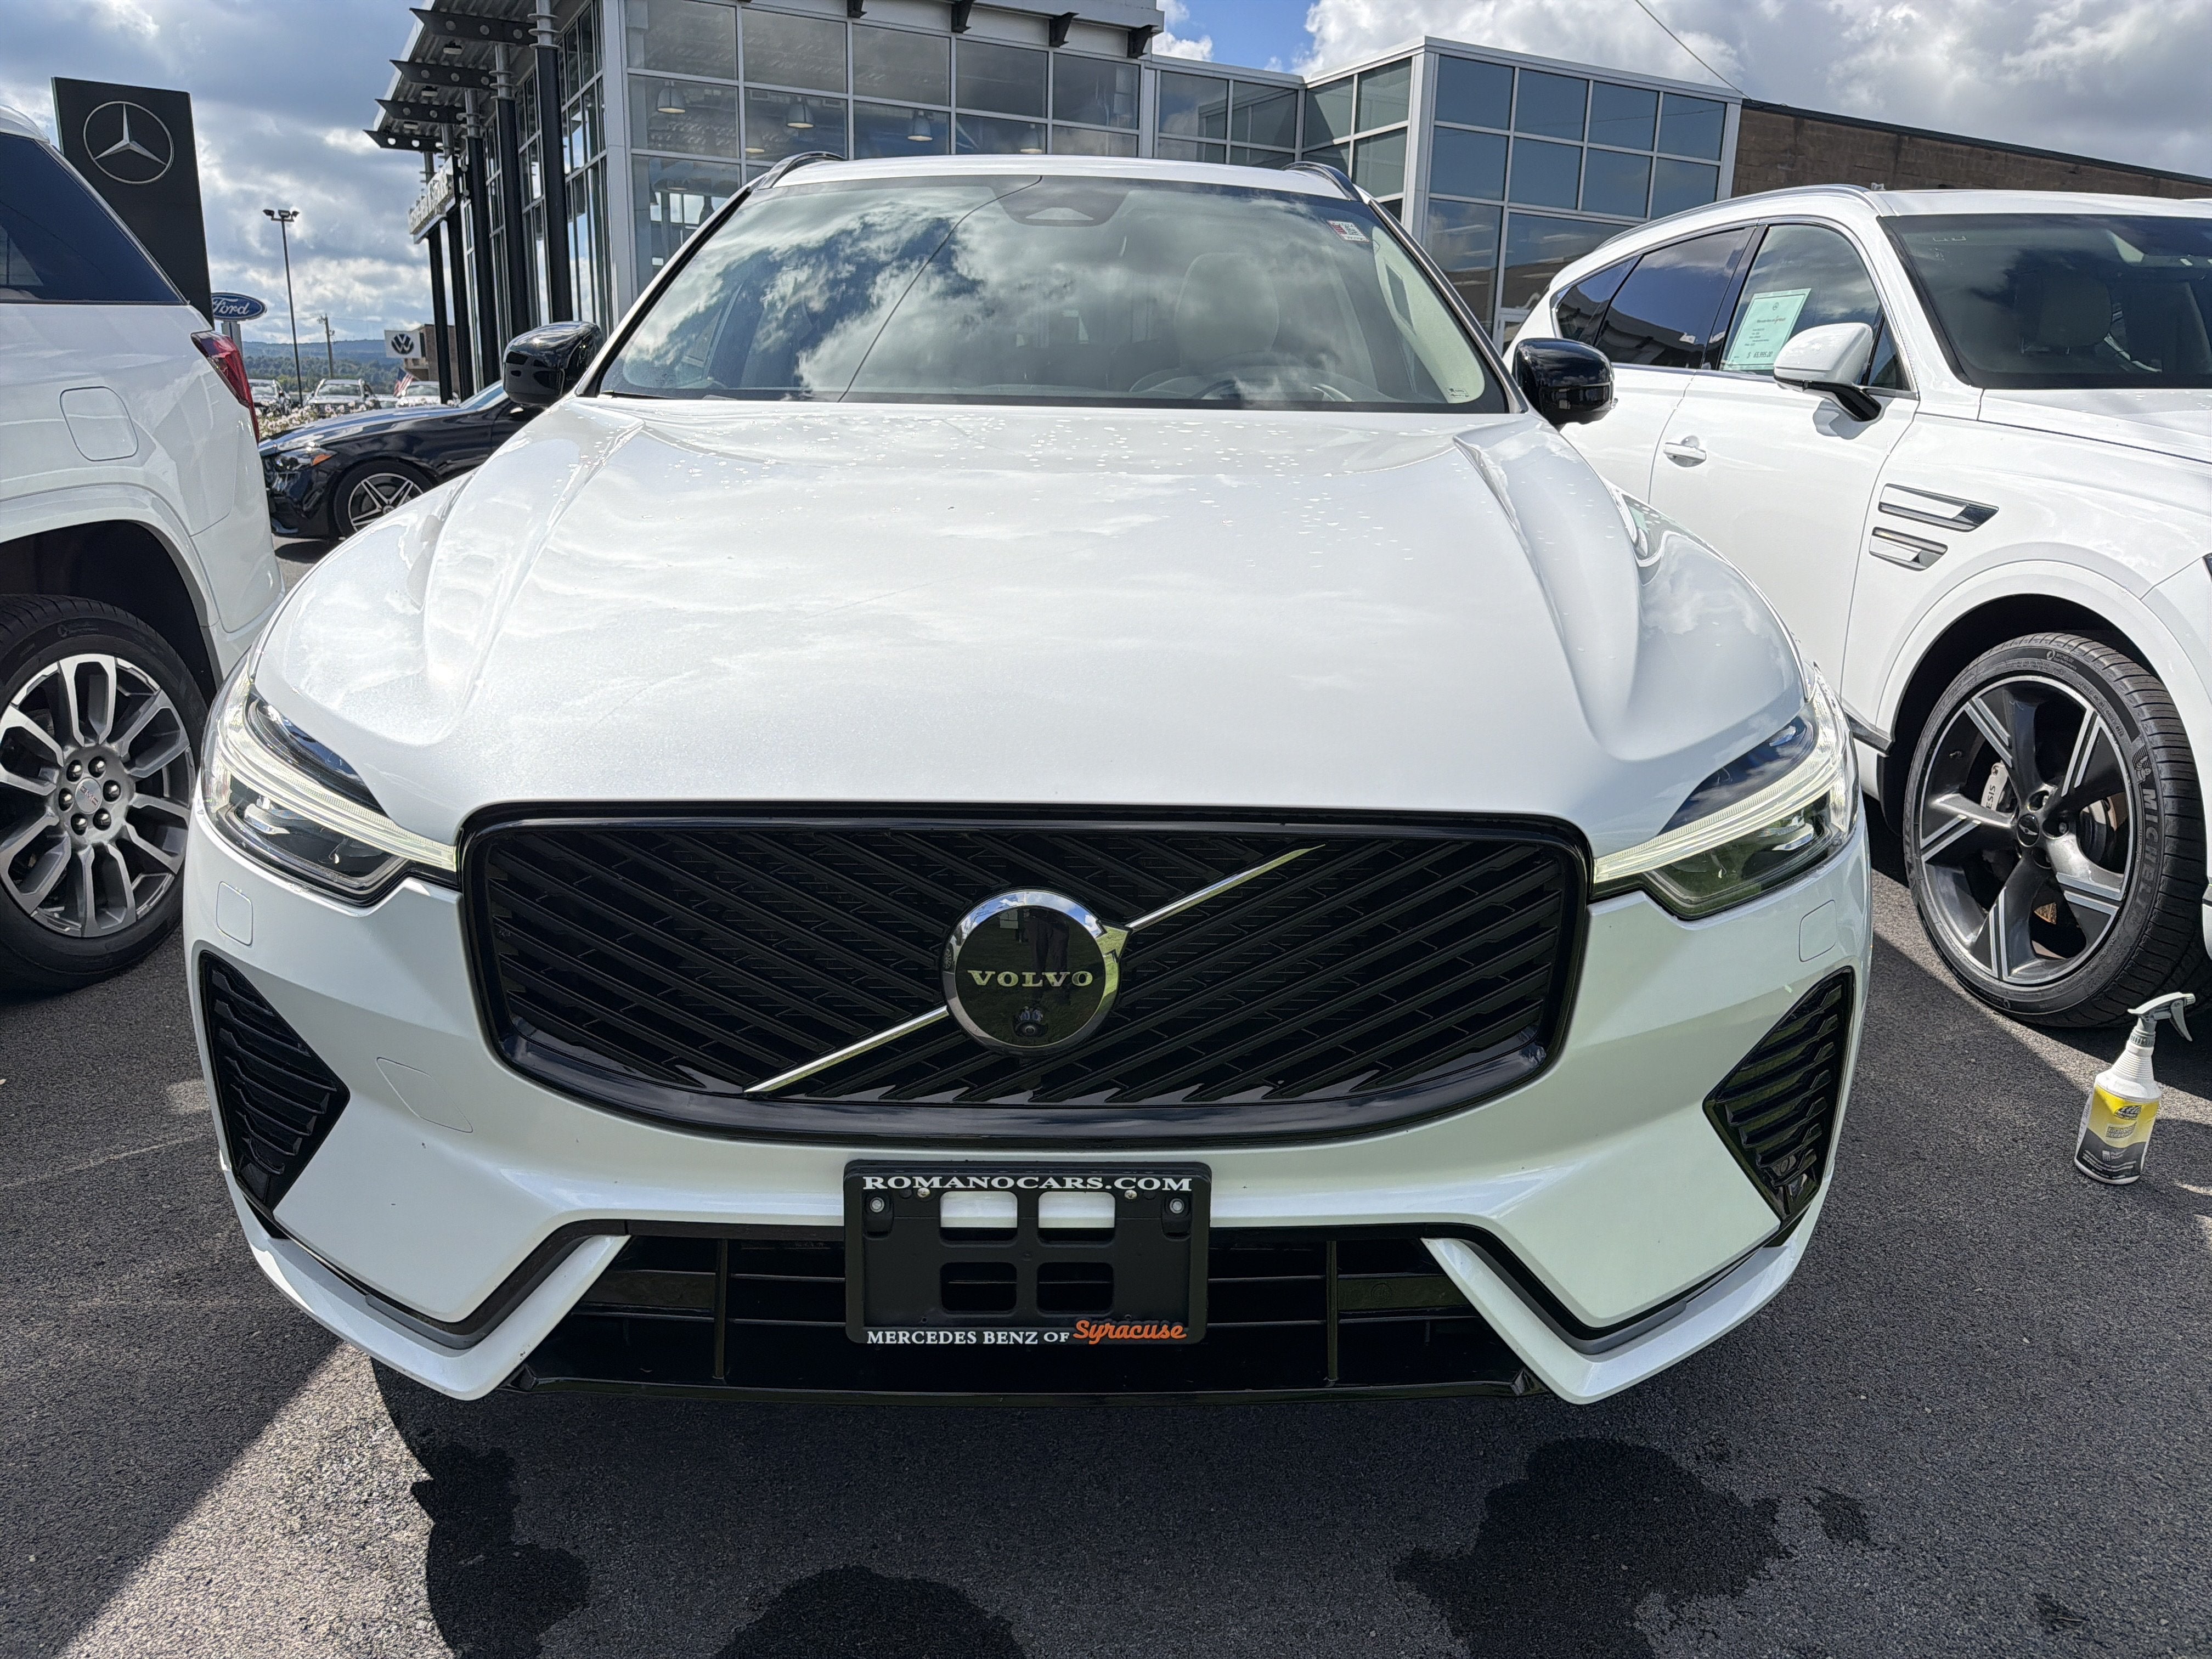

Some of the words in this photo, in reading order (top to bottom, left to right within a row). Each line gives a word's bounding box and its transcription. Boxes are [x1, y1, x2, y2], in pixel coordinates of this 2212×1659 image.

[212, 297, 250, 315] Ford
[80, 785, 99, 807] GMC
[967, 970, 1093, 987] VOLVO
[862, 1176, 1192, 1191] ROMANOCARS.COM
[867, 1331, 977, 1344] MERCEDES
[983, 1331, 1038, 1345] BENZ
[1043, 1332, 1069, 1342] OF
[1073, 1320, 1187, 1344] Syracuse
